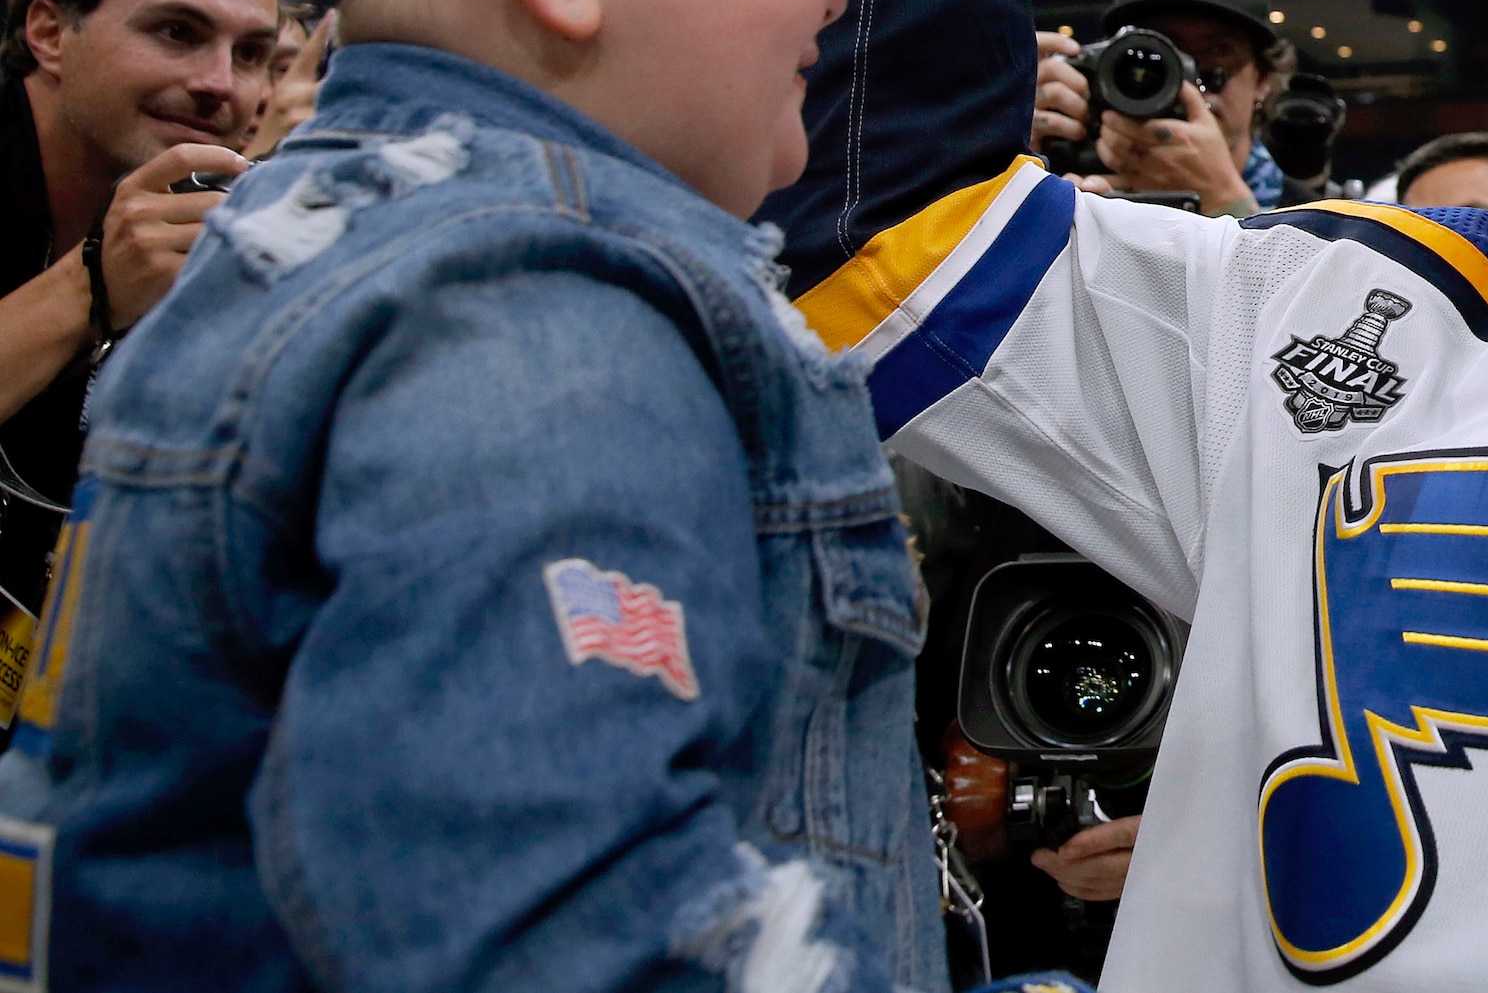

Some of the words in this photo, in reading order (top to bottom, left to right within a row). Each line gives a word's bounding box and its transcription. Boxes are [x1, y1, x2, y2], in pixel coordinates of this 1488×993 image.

[1311, 338, 1367, 364] STANLEY
[1365, 357, 1395, 375] CUP
[1282, 343, 1398, 401] FINAL
[1307, 379, 1353, 401] 2019
[1301, 408, 1327, 421] NHL
